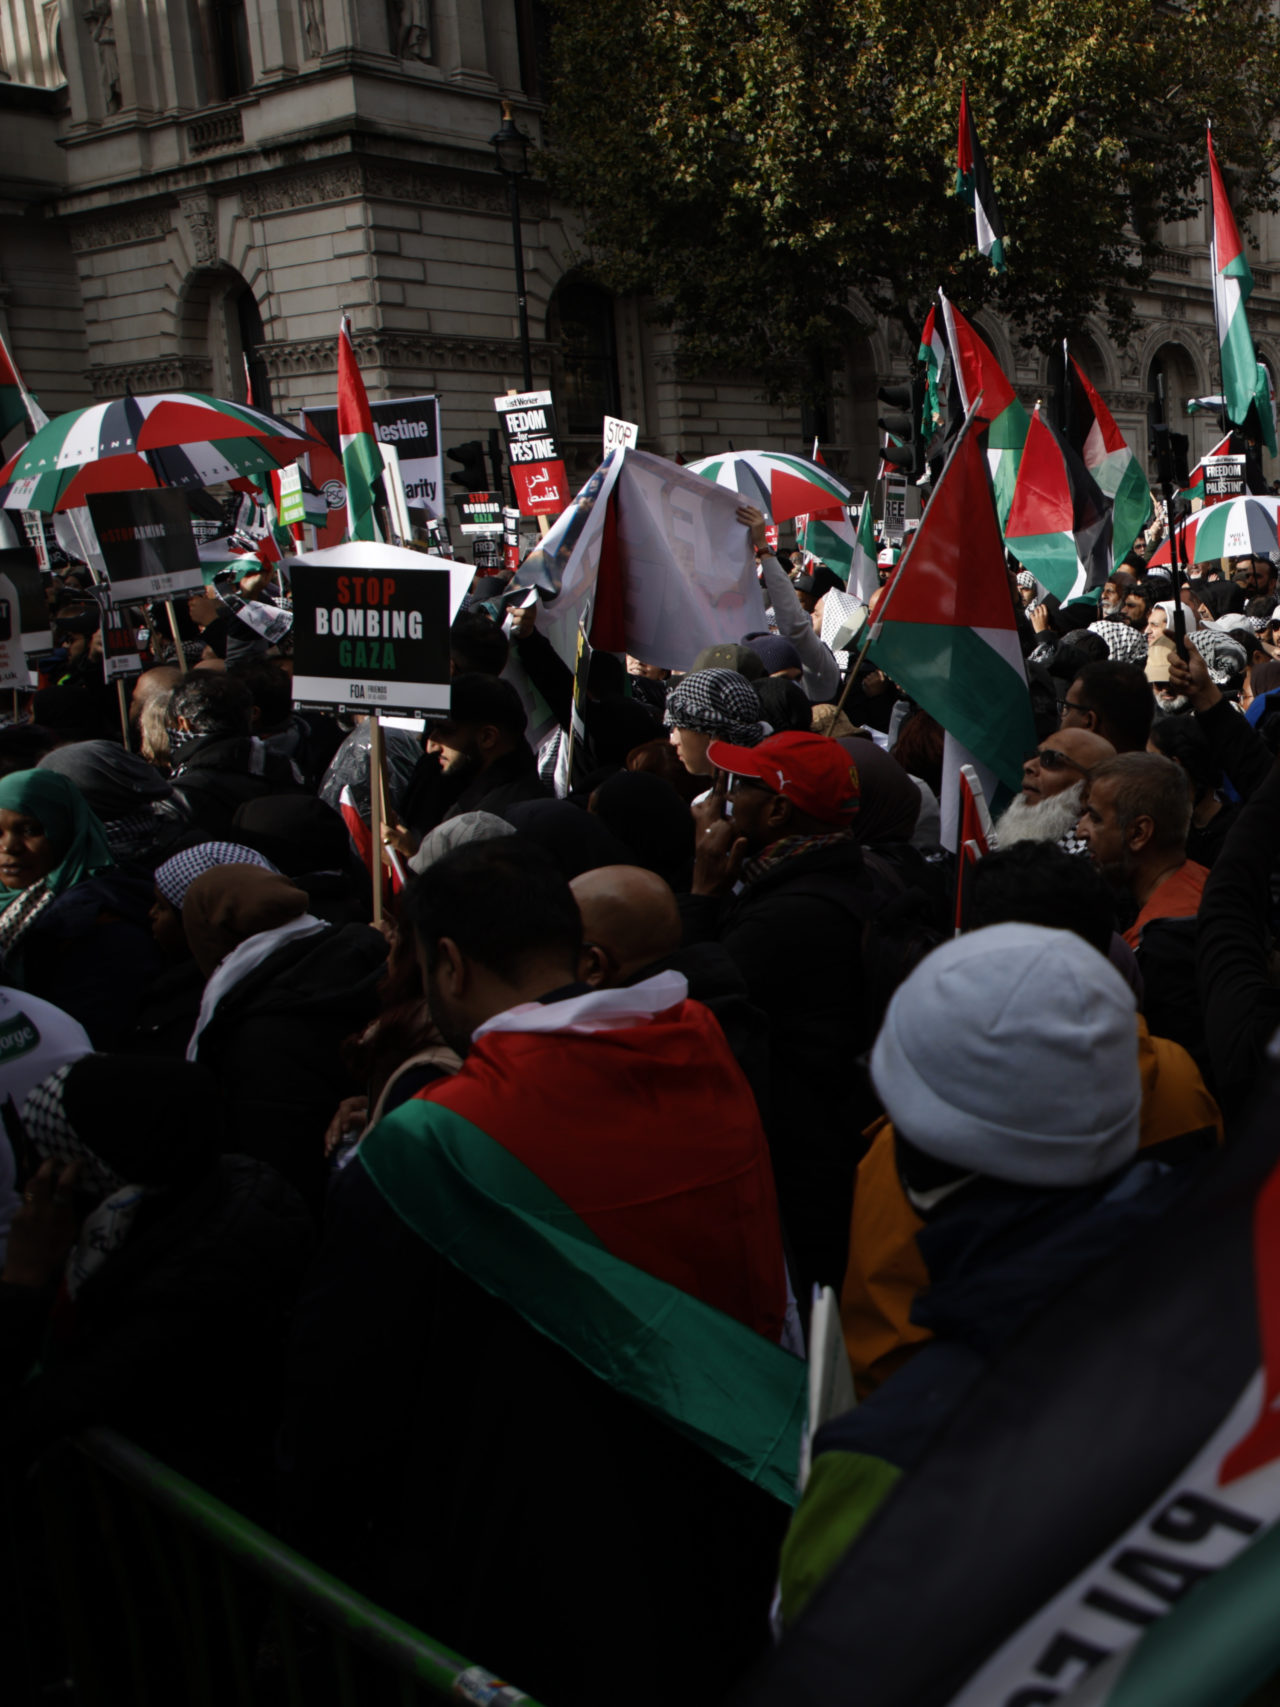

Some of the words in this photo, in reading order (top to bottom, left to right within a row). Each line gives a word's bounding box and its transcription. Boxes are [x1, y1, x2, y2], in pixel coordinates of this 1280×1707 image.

[373, 418, 429, 441] lestine
[607, 421, 632, 446] STOP
[405, 478, 437, 500] arity
[337, 575, 396, 606] STOP
[315, 607, 423, 640] BOMBING
[339, 640, 396, 670] GAZA
[350, 684, 366, 699] FOA
[0, 1026, 35, 1049] orge
